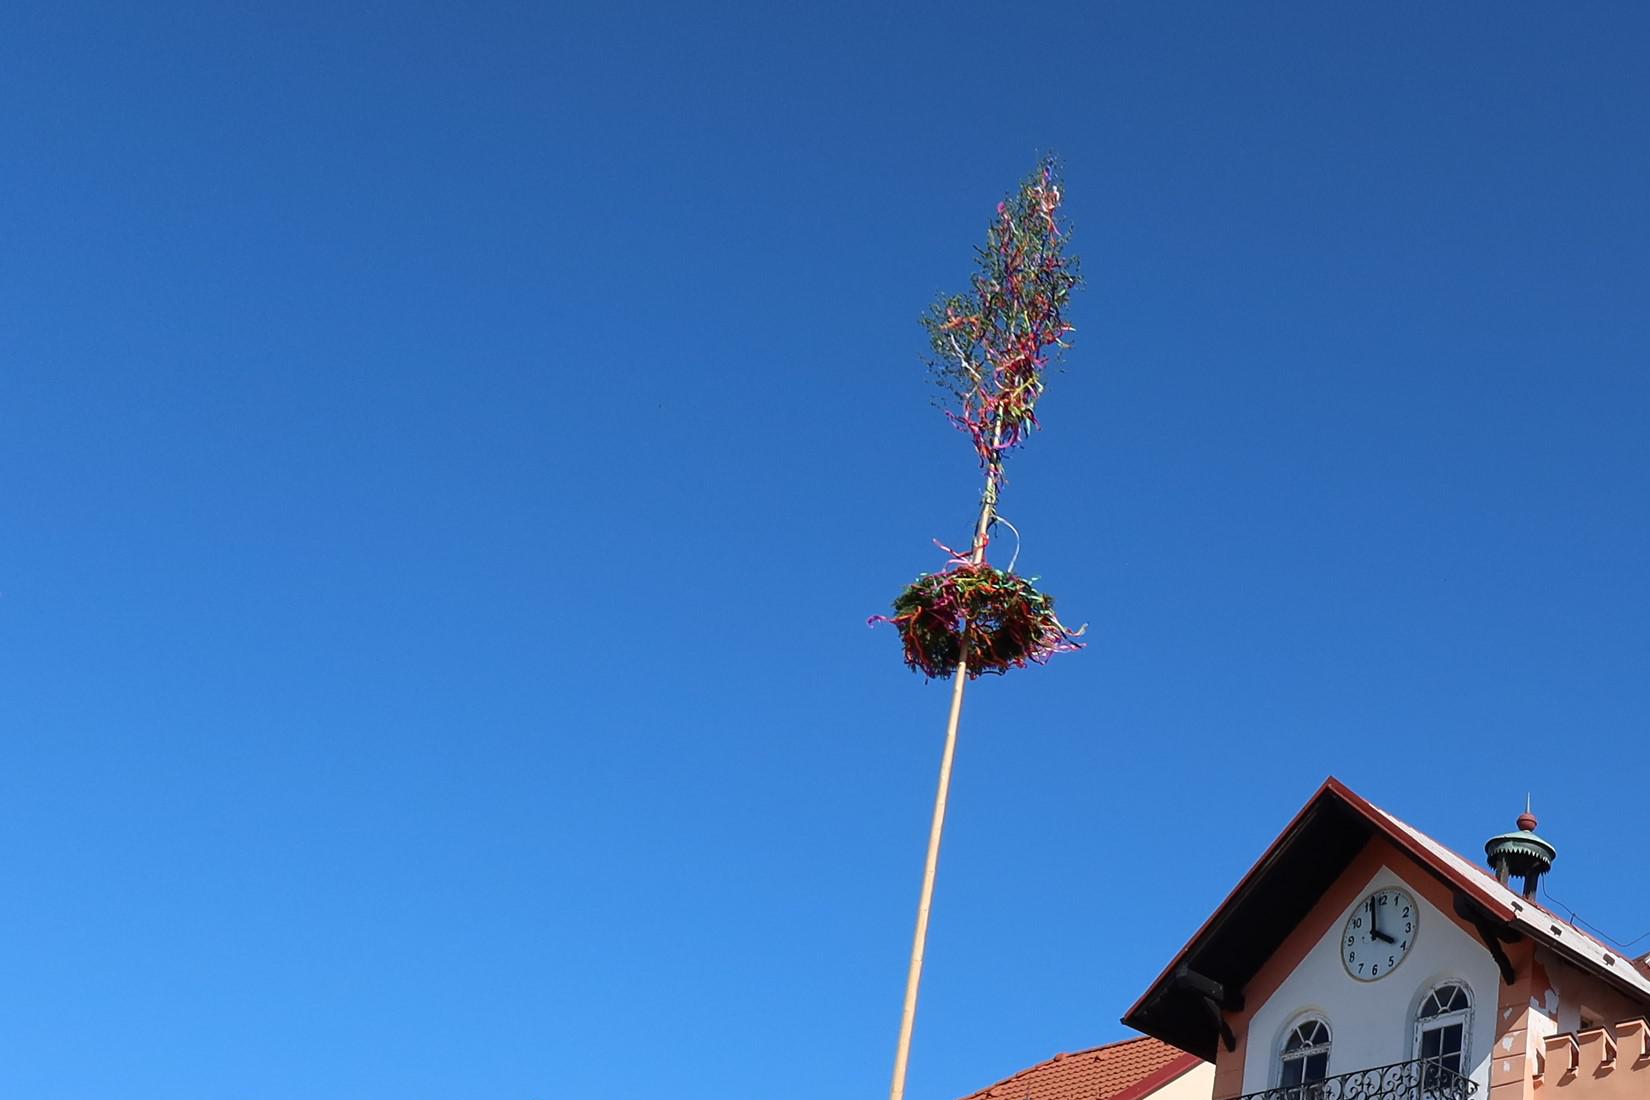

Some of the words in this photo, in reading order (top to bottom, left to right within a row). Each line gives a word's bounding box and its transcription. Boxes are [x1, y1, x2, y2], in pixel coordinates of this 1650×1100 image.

[1378, 895, 1388, 906] 12
[1402, 906, 1409, 918] 2
[1352, 917, 1361, 929] 10
[1405, 922, 1411, 933] 3
[1347, 936, 1354, 947] 9
[1400, 940, 1407, 951] 4
[1349, 951, 1355, 963] 8
[1388, 956, 1394, 967] 5
[1358, 963, 1364, 974] 7
[1371, 964, 1378, 976] 6
